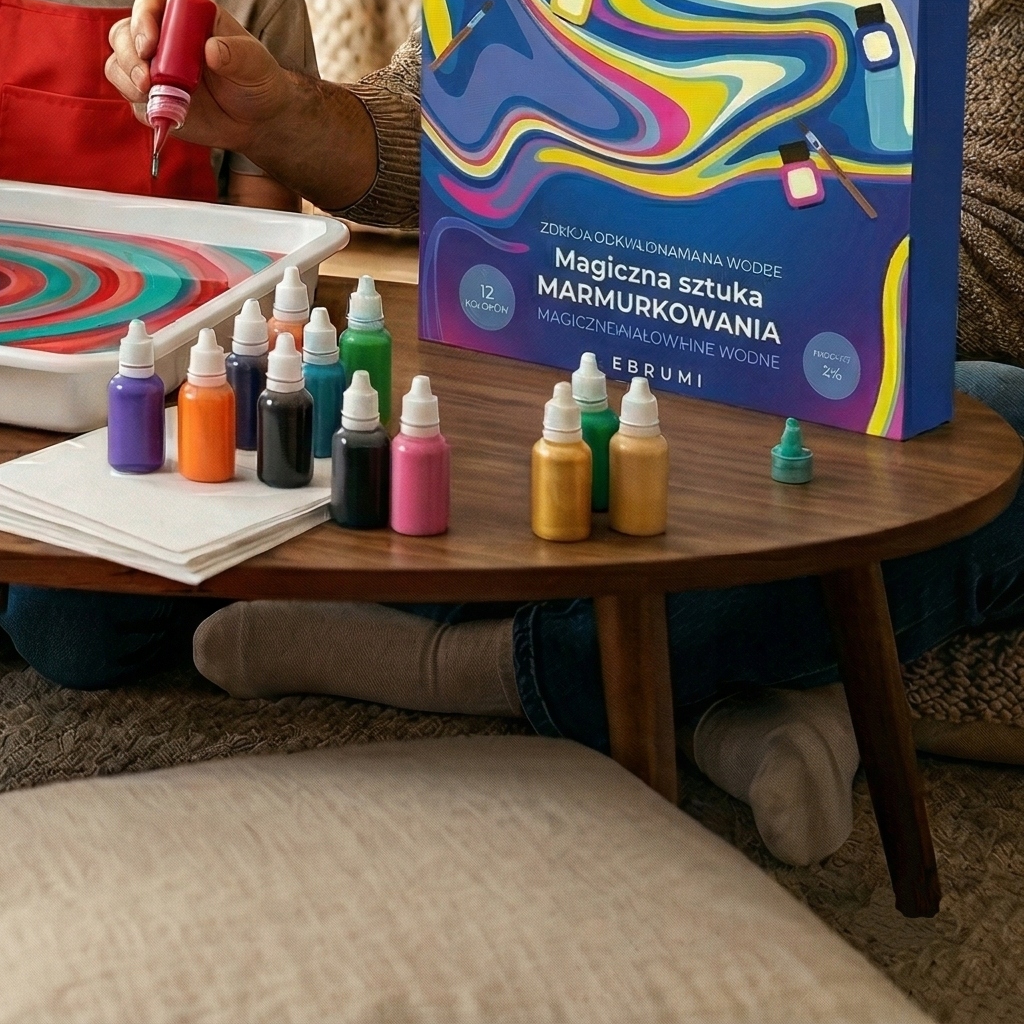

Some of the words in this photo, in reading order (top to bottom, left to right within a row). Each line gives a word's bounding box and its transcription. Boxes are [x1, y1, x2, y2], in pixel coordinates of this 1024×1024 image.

[480, 284, 495, 300] 12
[555, 246, 671, 290] Magiczna
[678, 276, 763, 308] sztuka
[538, 274, 782, 345] MARMURKOWANIA
[612, 356, 702, 388] EBRUMI
[719, 344, 781, 370] WODNE
